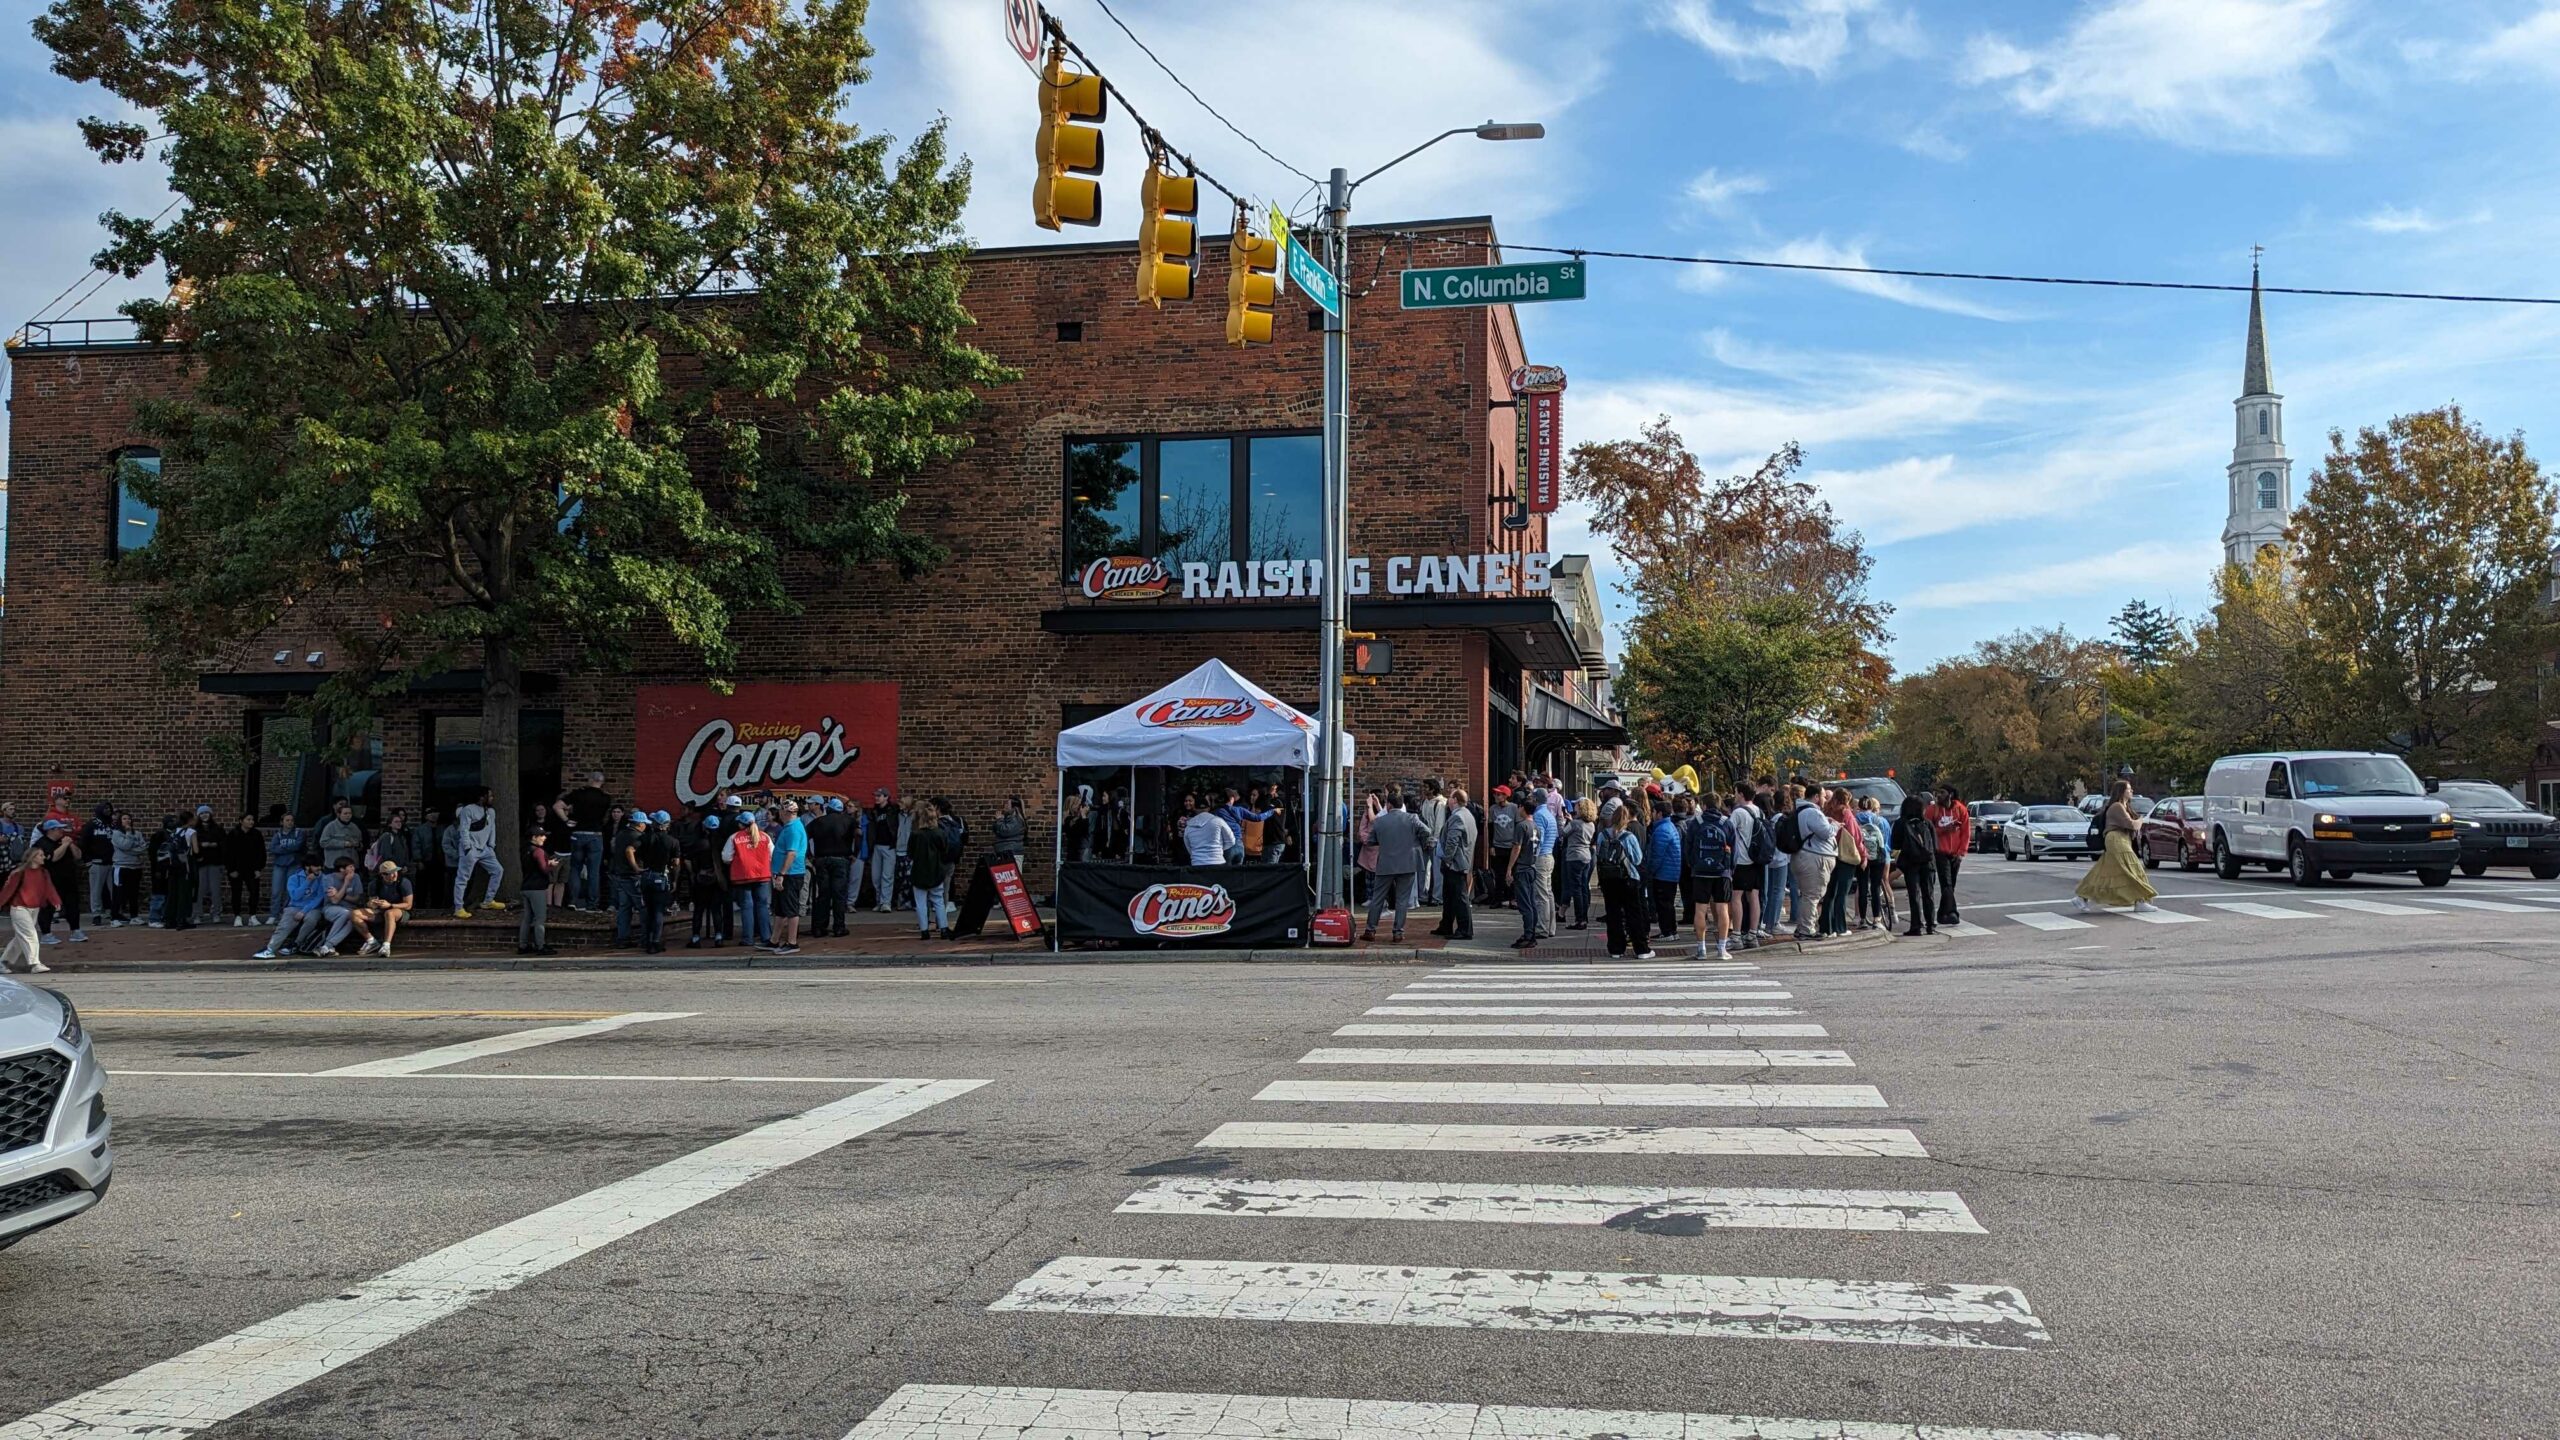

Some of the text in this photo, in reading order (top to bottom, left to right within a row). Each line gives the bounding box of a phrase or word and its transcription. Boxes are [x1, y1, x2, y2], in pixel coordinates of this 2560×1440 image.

[1300, 255, 1326, 300] Franklin
[1328, 278, 1334, 291] St
[1414, 267, 1576, 301] N. Columbia St
[1538, 399, 1550, 503] RAISING CANE'S
[1083, 557, 1167, 598] Cane's
[1387, 552, 1552, 593] CANE'S
[738, 721, 801, 740] Raising
[1138, 697, 1256, 728] Cane's
[675, 717, 858, 806] Cane's
[1134, 886, 1232, 932] Cane's
